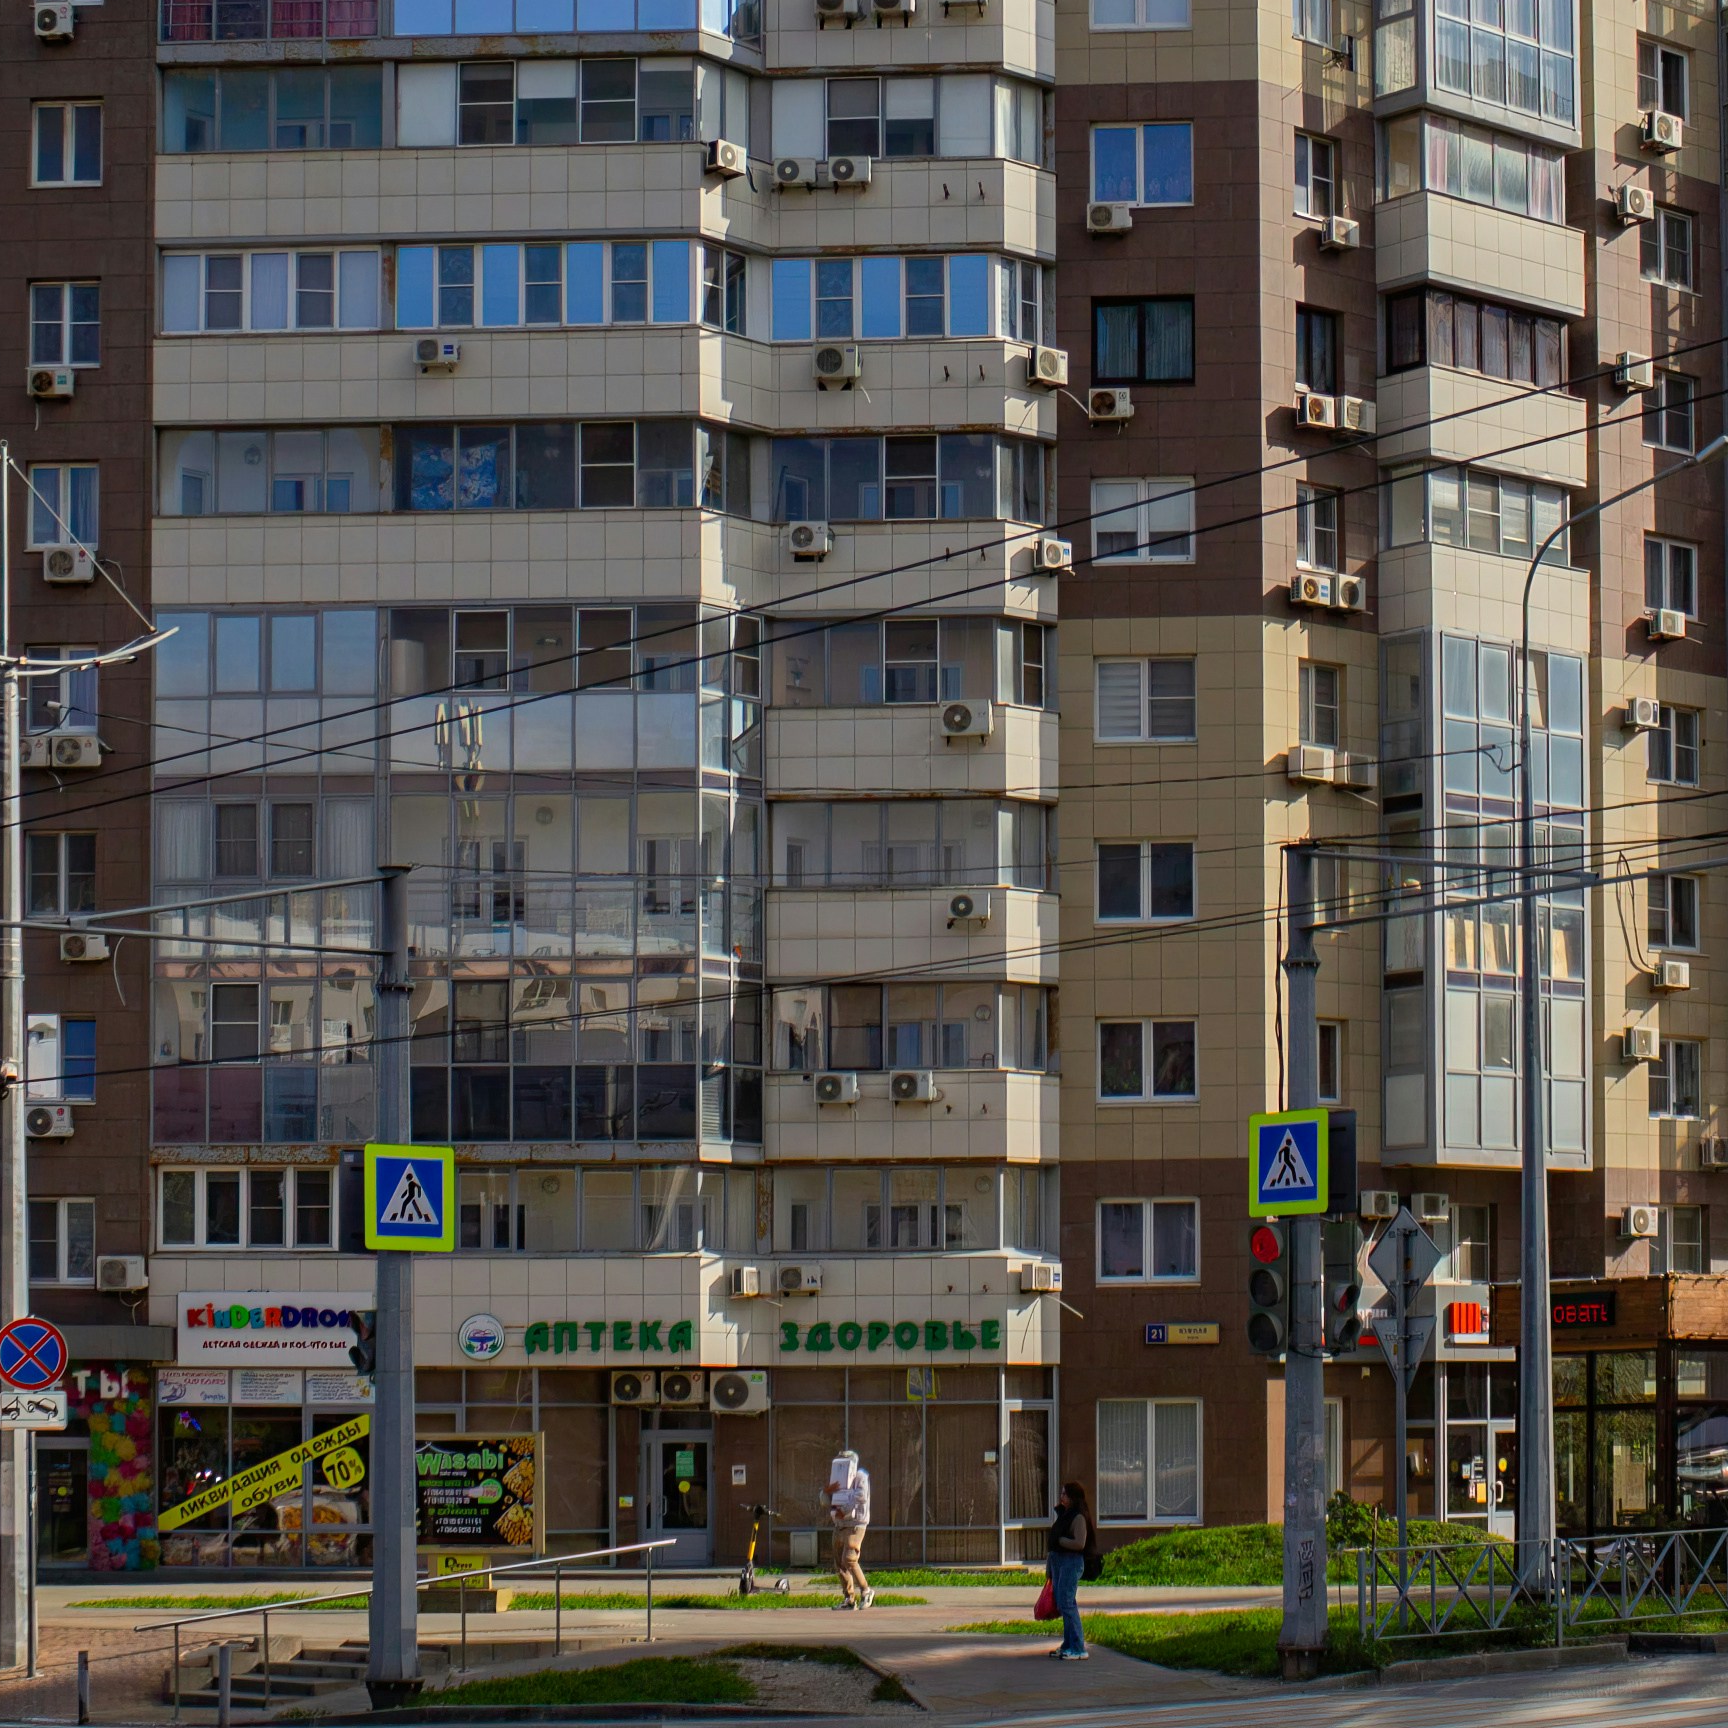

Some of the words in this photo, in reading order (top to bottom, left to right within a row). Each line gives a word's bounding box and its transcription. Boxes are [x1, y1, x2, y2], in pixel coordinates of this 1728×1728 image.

[524, 1320, 693, 1355] АПТЕКА
[779, 1319, 1001, 1352] ЗДОРОВЬЕ
[1151, 1328, 1163, 1339] 21
